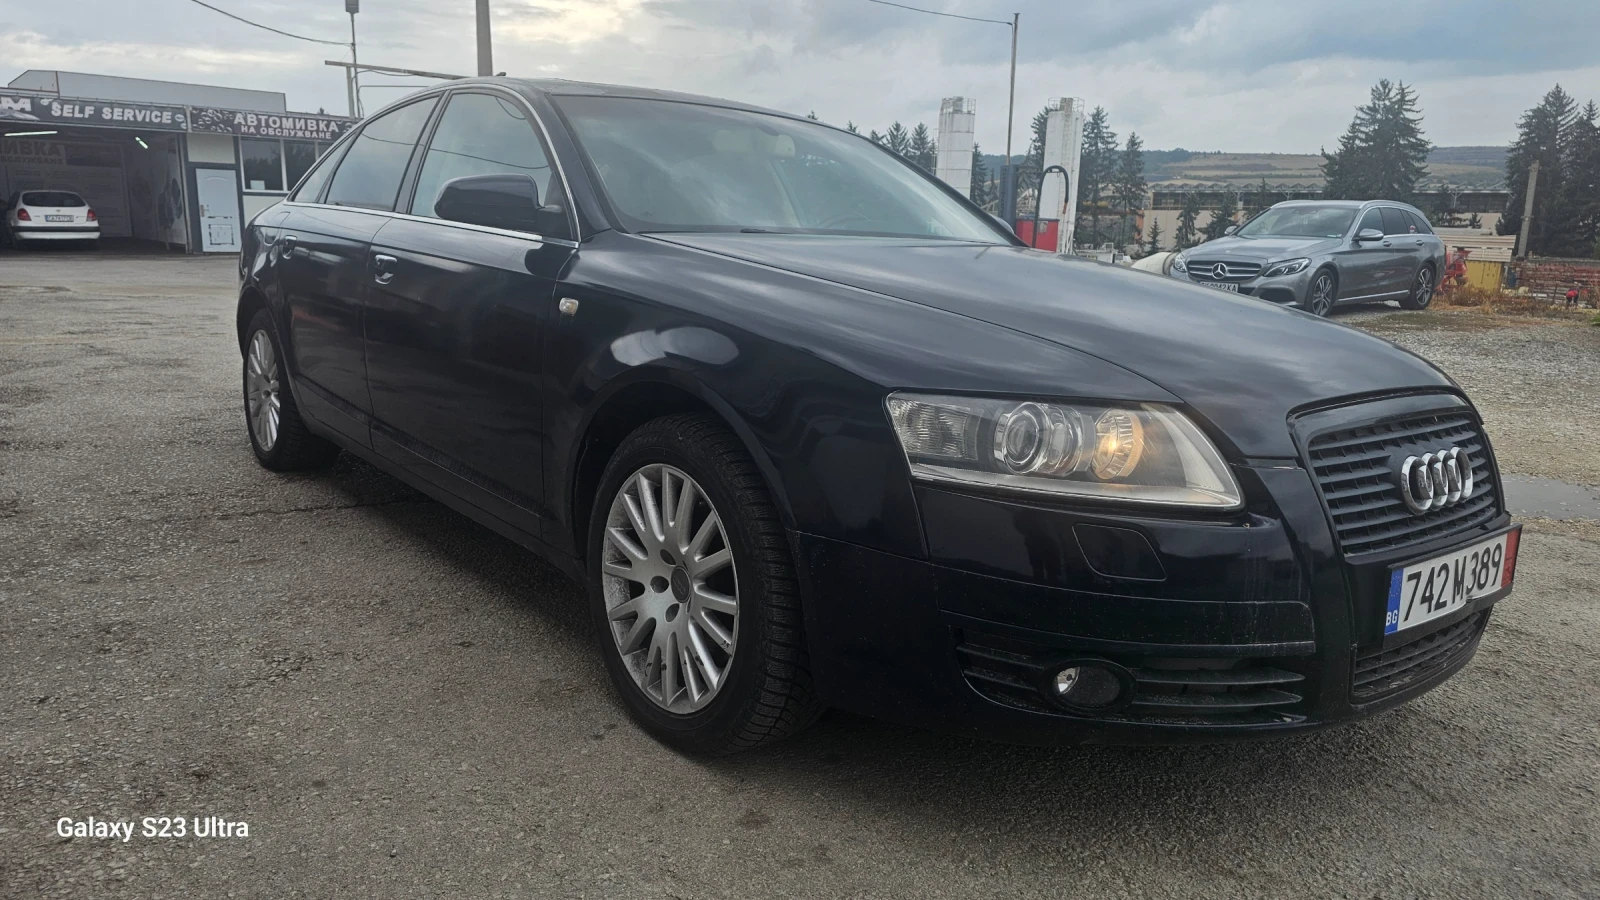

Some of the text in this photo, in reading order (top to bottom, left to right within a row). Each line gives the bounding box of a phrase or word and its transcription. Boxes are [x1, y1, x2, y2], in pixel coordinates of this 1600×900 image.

[51, 101, 172, 124] SELF SERVICE
[233, 113, 339, 133] АВТОМИВКА
[241, 125, 332, 139] НА ОБСЛУЖВАНЕ
[1403, 543, 1503, 622] 742M389
[1386, 610, 1398, 626] BG
